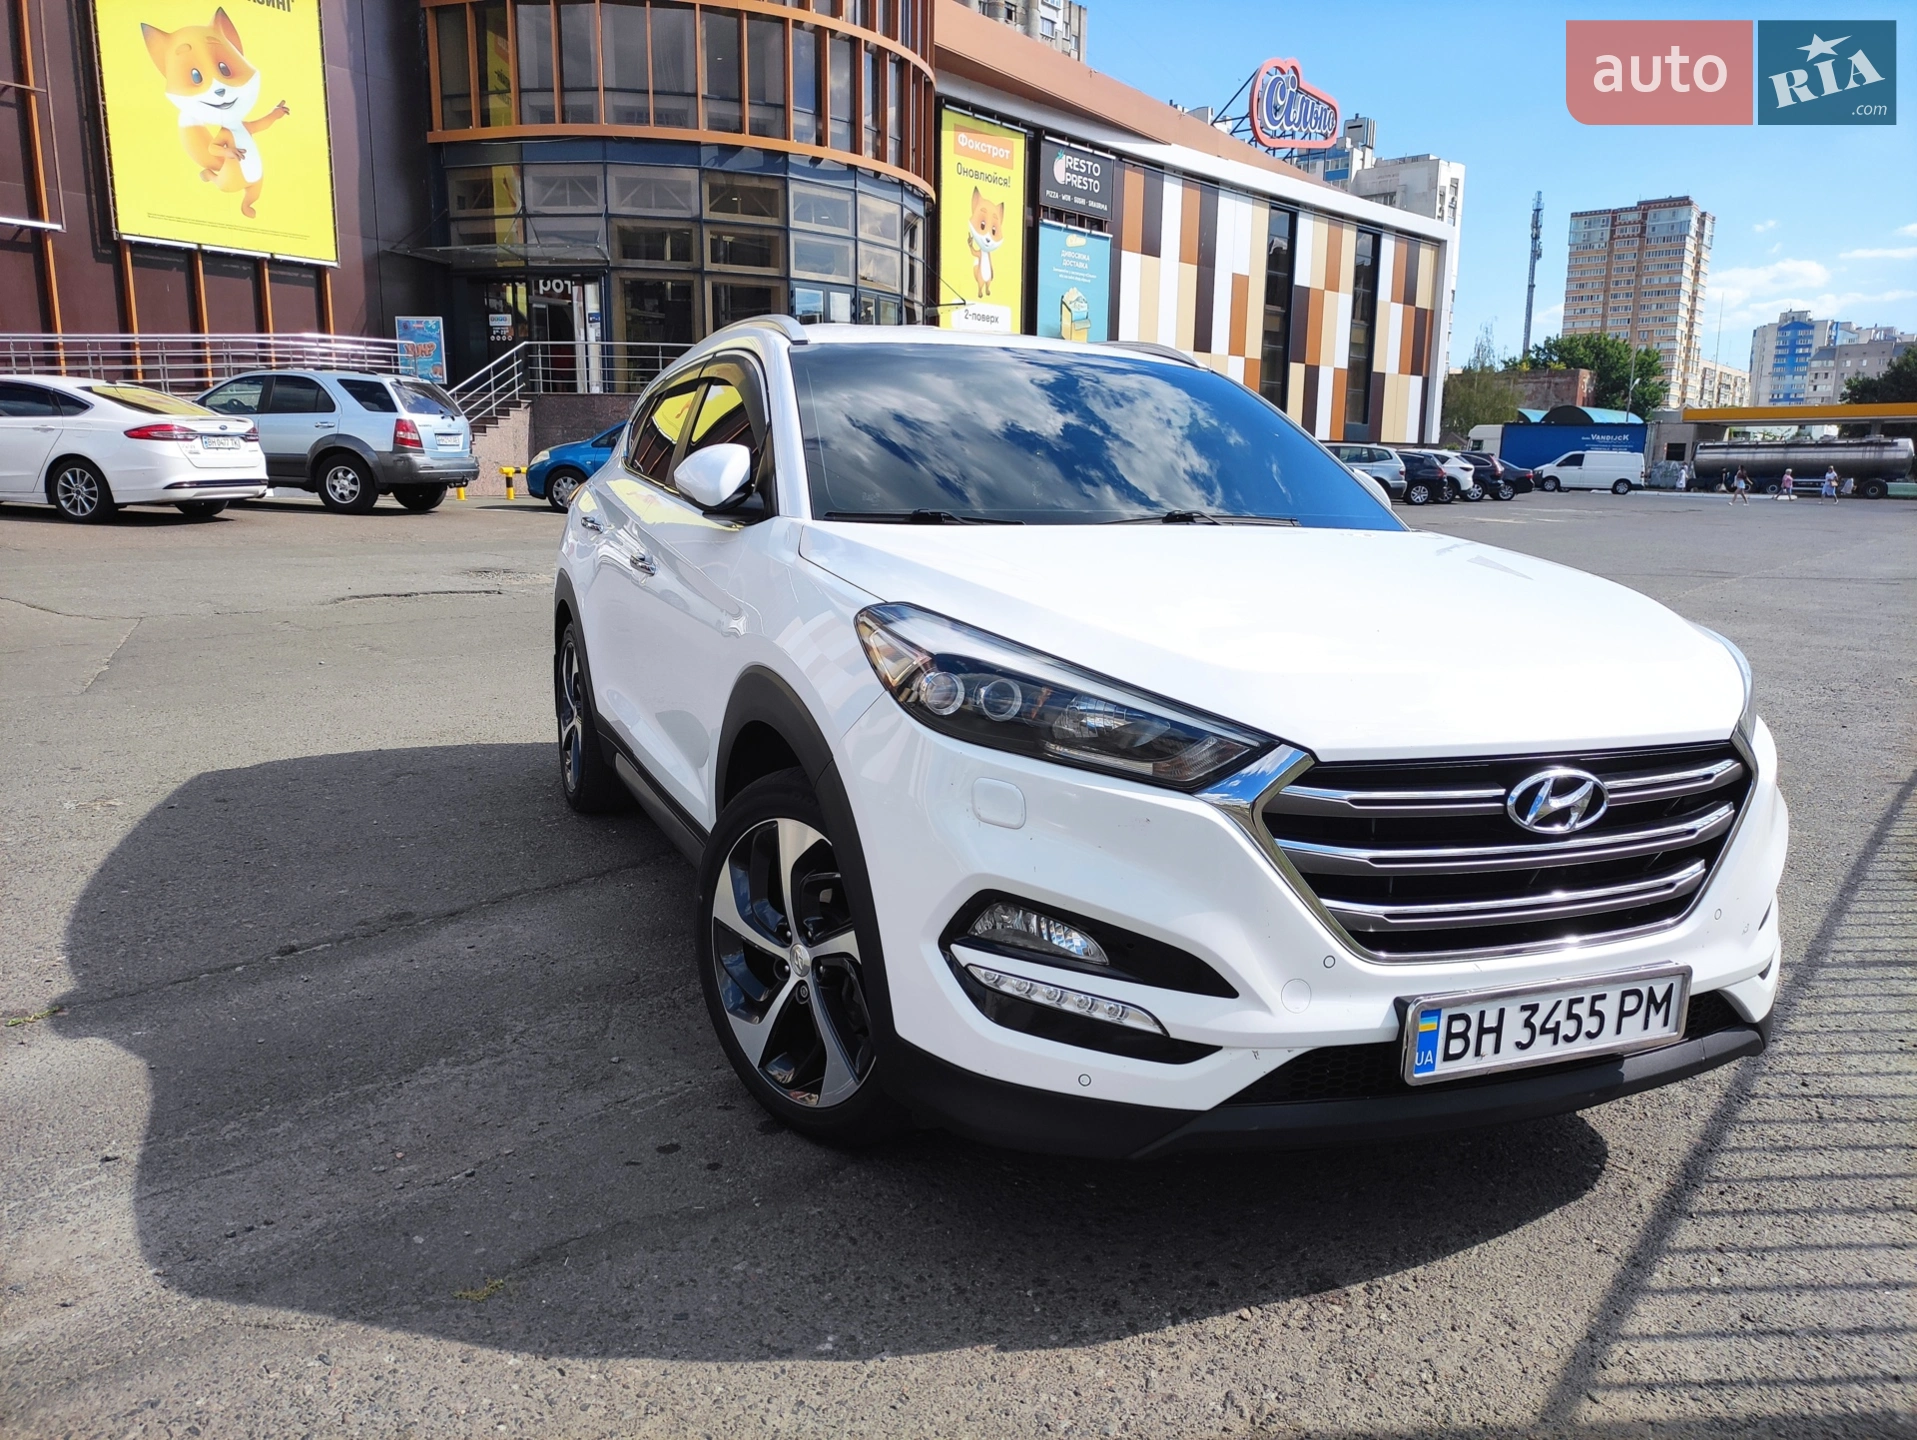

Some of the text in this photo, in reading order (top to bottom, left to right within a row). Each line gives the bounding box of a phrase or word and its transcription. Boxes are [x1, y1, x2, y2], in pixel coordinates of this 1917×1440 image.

[1263, 74, 1336, 137] Сільпо
[958, 133, 1010, 159] Фокстрот
[956, 162, 1011, 188] Оновлюйся!
[1065, 155, 1101, 177] RESTO
[1046, 189, 1059, 199] PIZZA
[1065, 172, 1100, 194] PRESTO
[964, 308, 1000, 325] 2-поверх
[1443, 982, 1675, 1063] BH 3455 PM
[1415, 1051, 1434, 1066] UA
